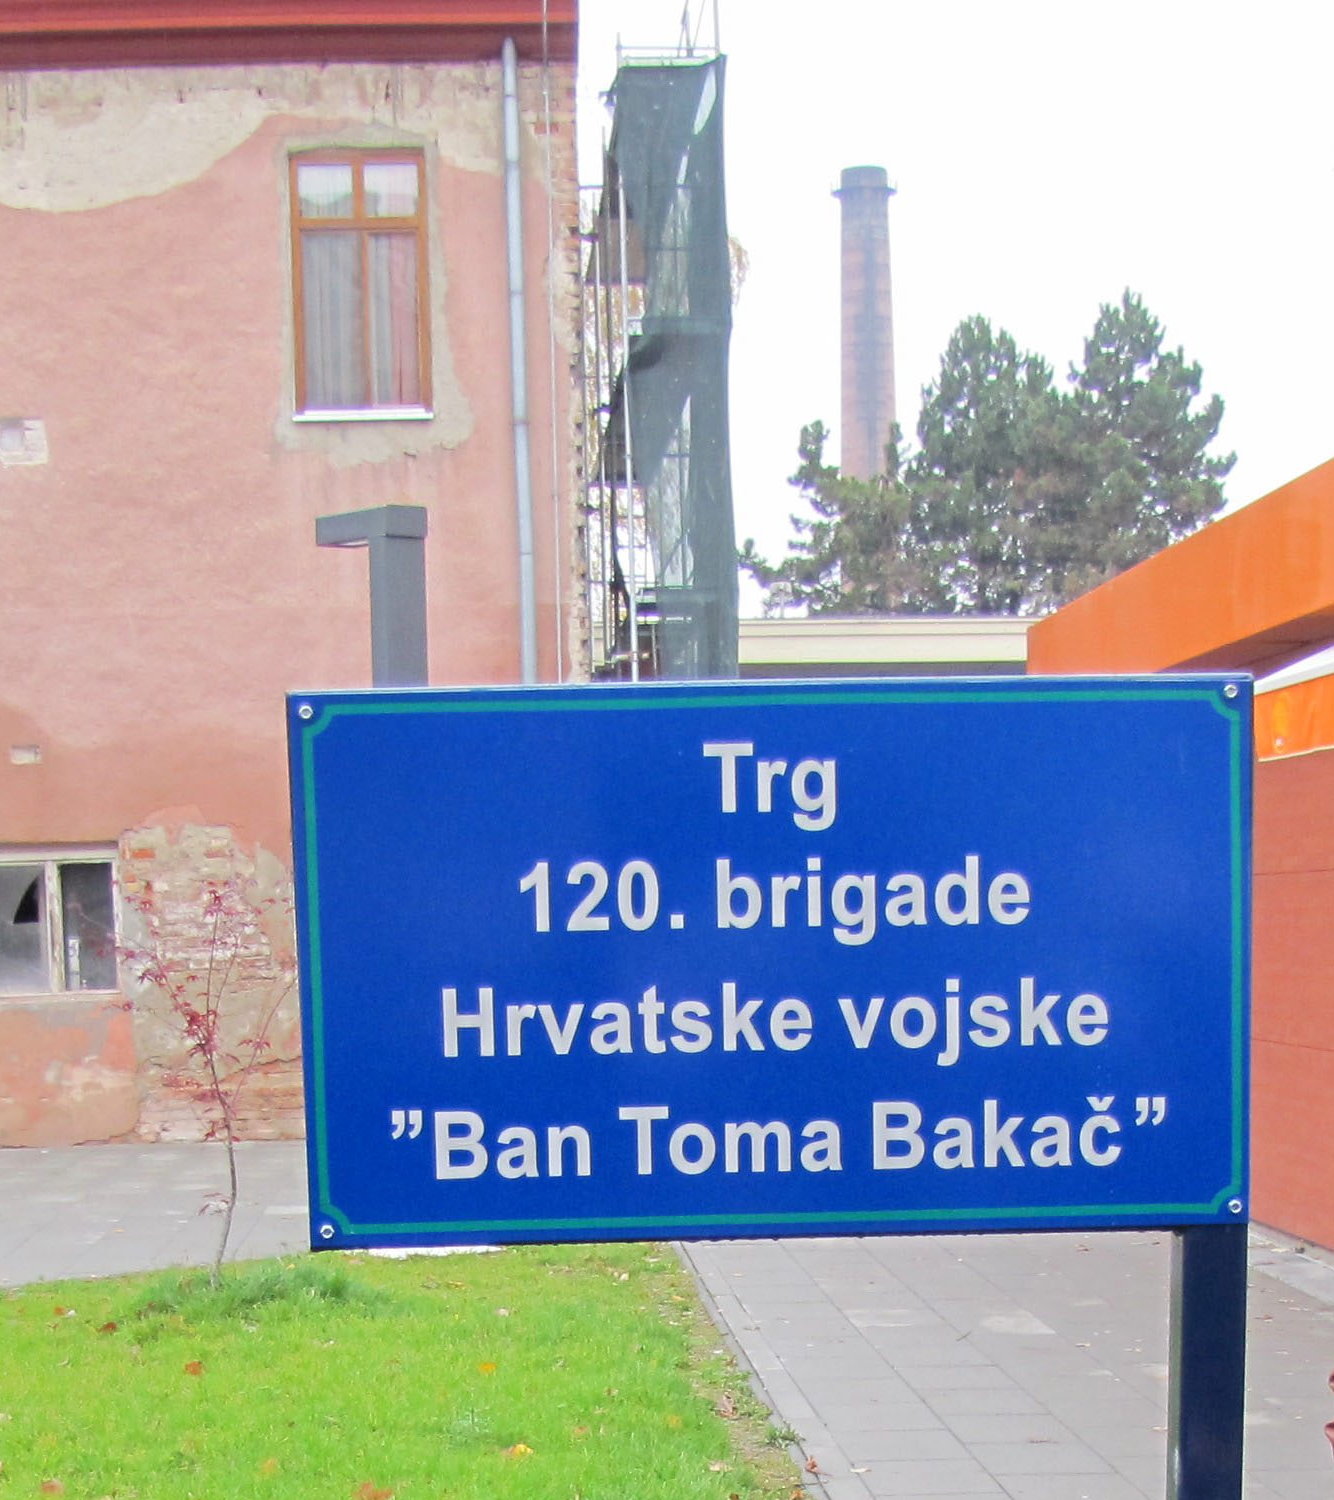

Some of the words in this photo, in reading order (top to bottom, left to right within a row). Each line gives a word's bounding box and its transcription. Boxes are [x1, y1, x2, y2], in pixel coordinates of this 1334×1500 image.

[703, 741, 837, 832] Trg
[519, 859, 685, 933] 120.
[717, 854, 1031, 946] brigade
[441, 985, 813, 1058] Hrvatske
[838, 976, 1110, 1067] vojske
[618, 1105, 843, 1175] Toma
